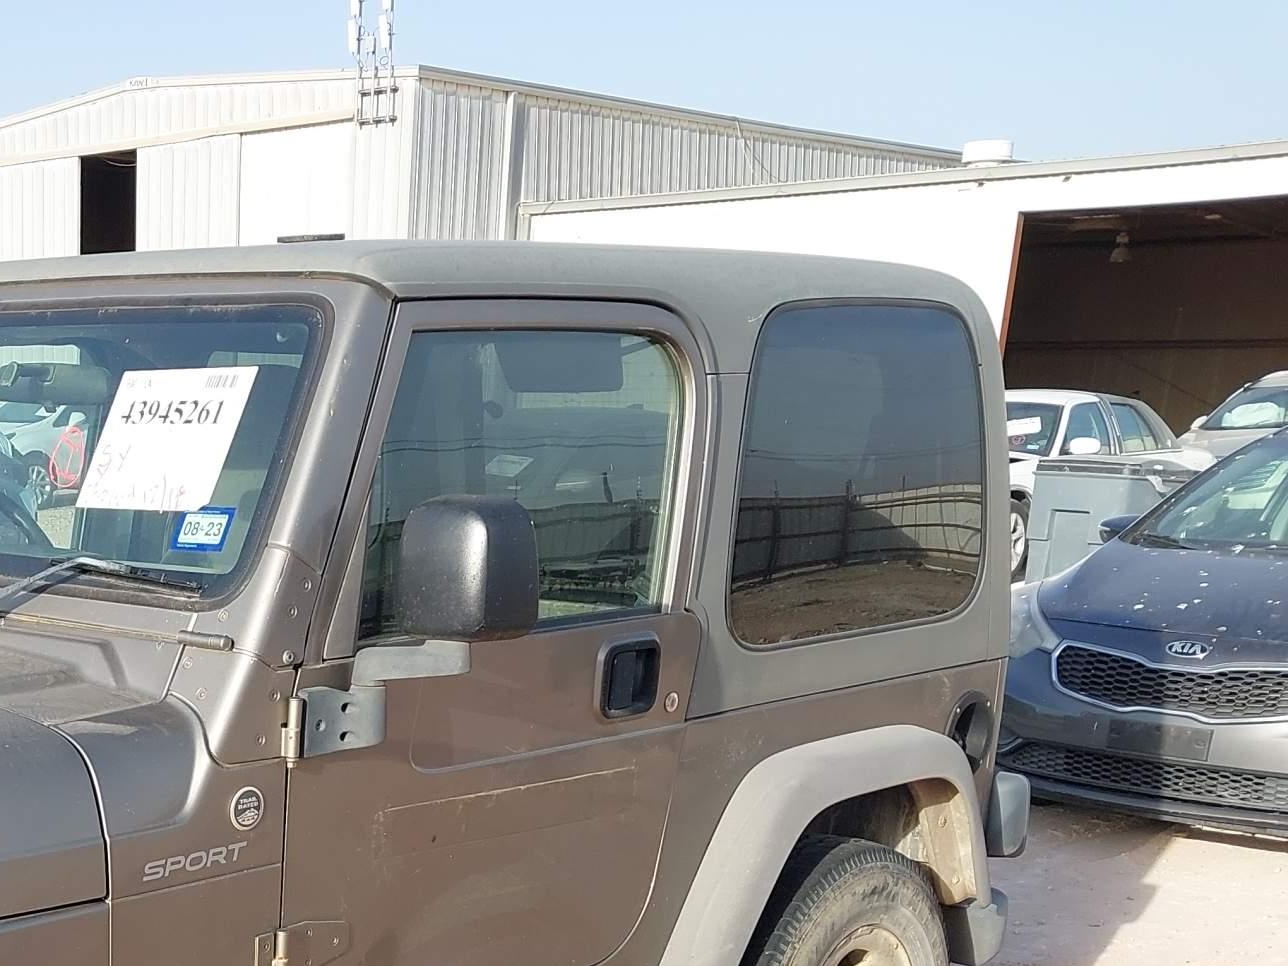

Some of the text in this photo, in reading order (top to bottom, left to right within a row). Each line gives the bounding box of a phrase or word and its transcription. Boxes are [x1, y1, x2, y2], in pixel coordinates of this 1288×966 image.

[120, 399, 225, 425] 43945261
[1171, 641, 1202, 655] KIA
[142, 840, 248, 882] SPORT
